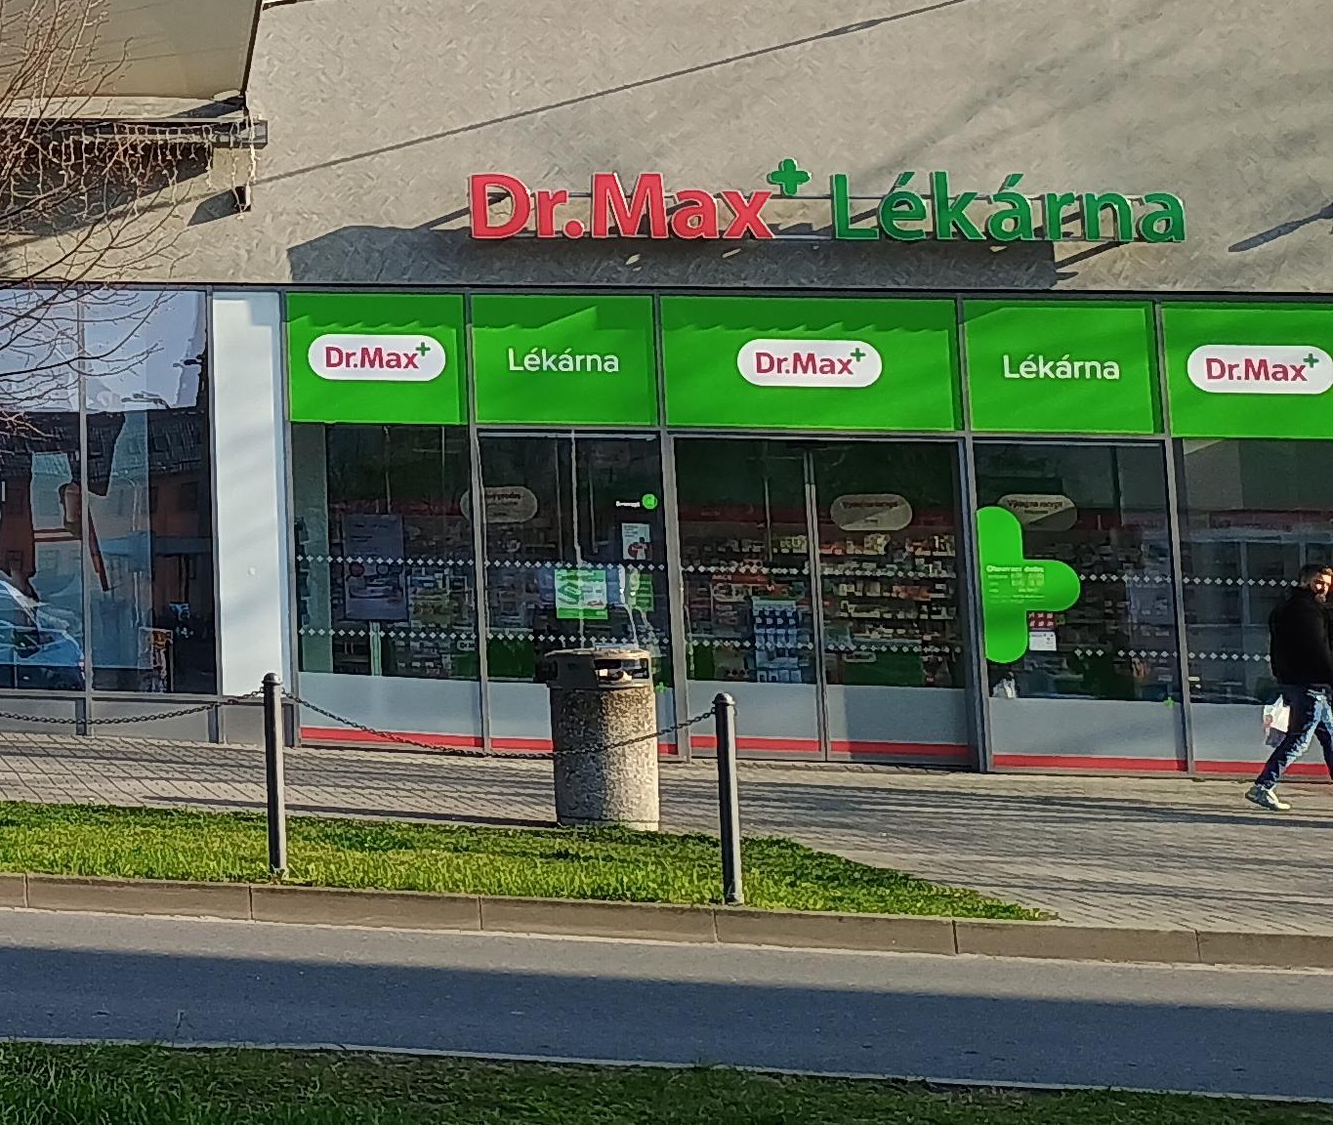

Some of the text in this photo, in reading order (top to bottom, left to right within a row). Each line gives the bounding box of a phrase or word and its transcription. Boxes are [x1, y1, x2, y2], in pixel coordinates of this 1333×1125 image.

[832, 170, 1187, 243] Lékárna
[508, 347, 620, 374] Lékárna
[1003, 353, 1120, 381] Lékárna
